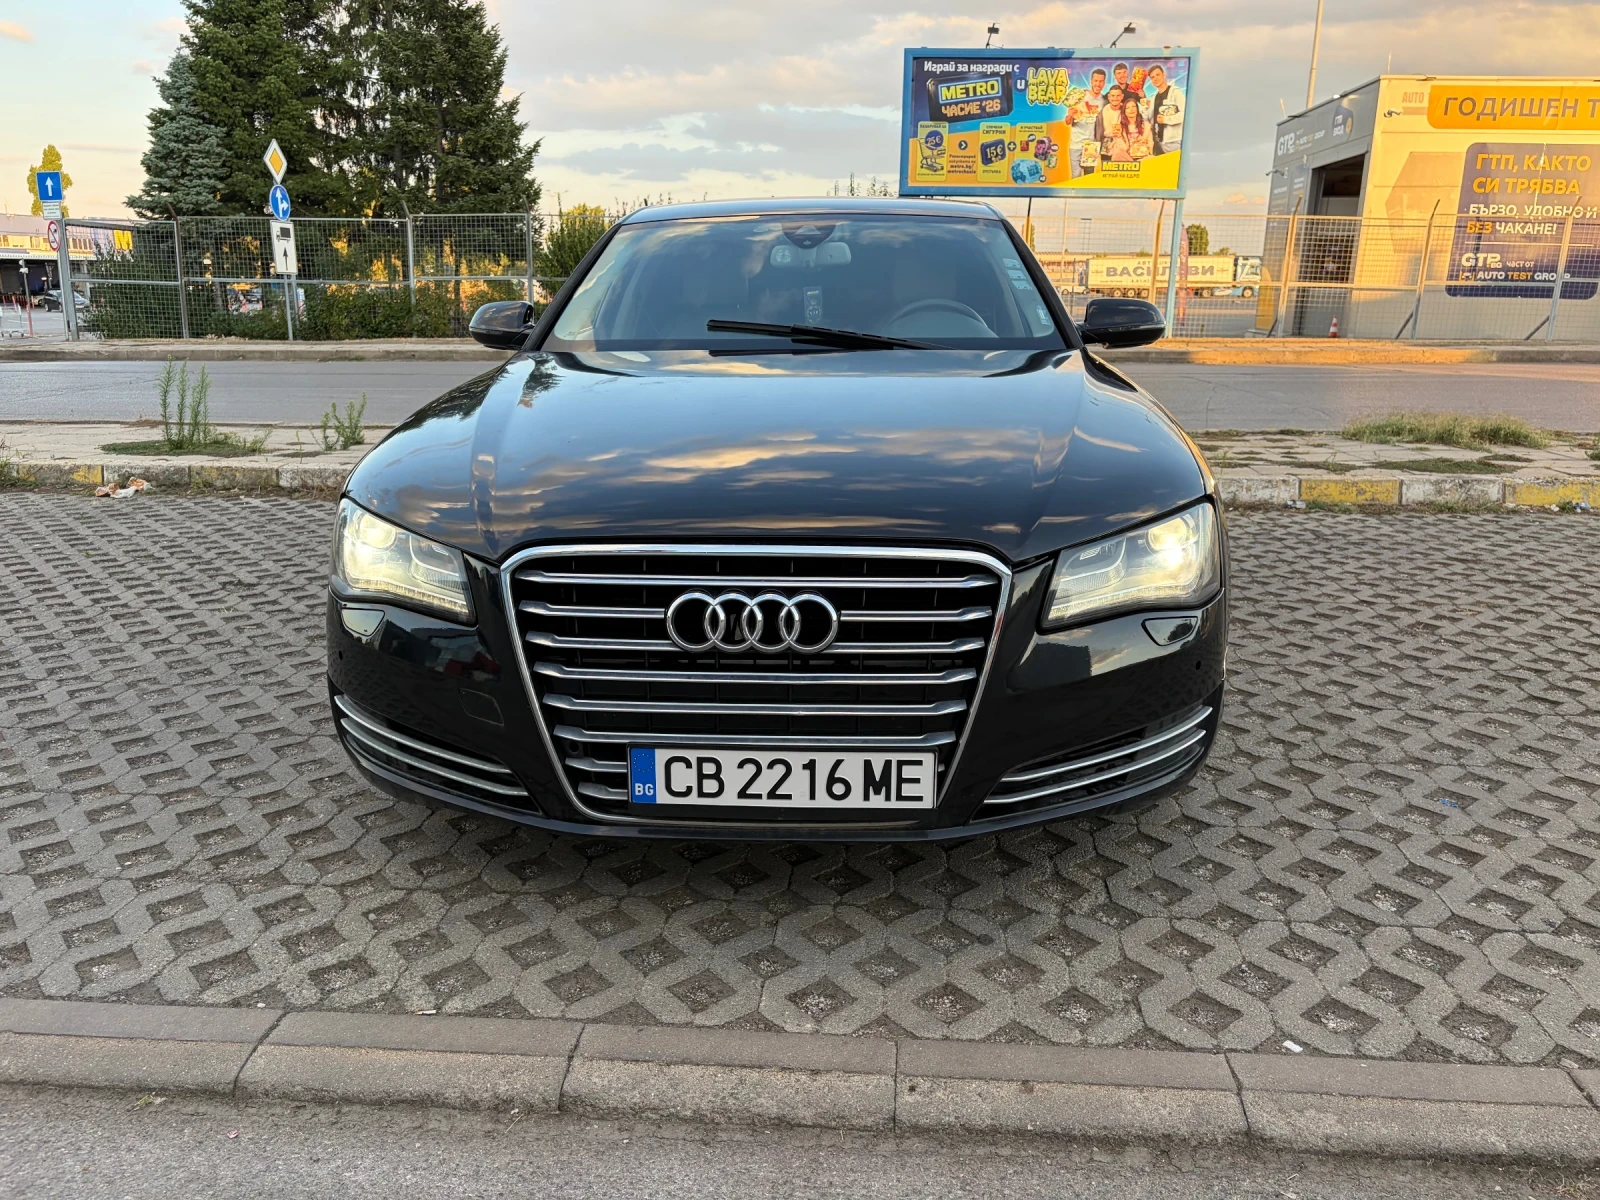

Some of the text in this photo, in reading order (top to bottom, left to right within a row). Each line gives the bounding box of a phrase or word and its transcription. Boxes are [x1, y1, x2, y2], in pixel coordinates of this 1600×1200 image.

[924, 61, 1020, 75] Играй за награди с
[1016, 78, 1026, 90] и
[1028, 68, 1068, 87] LAVA
[941, 80, 999, 101] METRO
[1027, 86, 1067, 104] BEAR
[1401, 91, 1424, 104] AUTO
[1443, 97, 1579, 121] ГОДИШЕН
[1102, 161, 1140, 171] METRO
[1475, 153, 1592, 173] ГТП, КАКТО
[1472, 176, 1581, 195] СИ ТРЯБВА
[1523, 204, 1584, 220] УДОБНО
[1466, 220, 1558, 235] БЕЗ ЧАКАНЕ!
[1105, 265, 1215, 278] ВАСИЛВИ
[1476, 271, 1571, 281] AUTO TEST GROP
[664, 754, 924, 802] CB 2216 ME
[634, 782, 655, 796] BG
